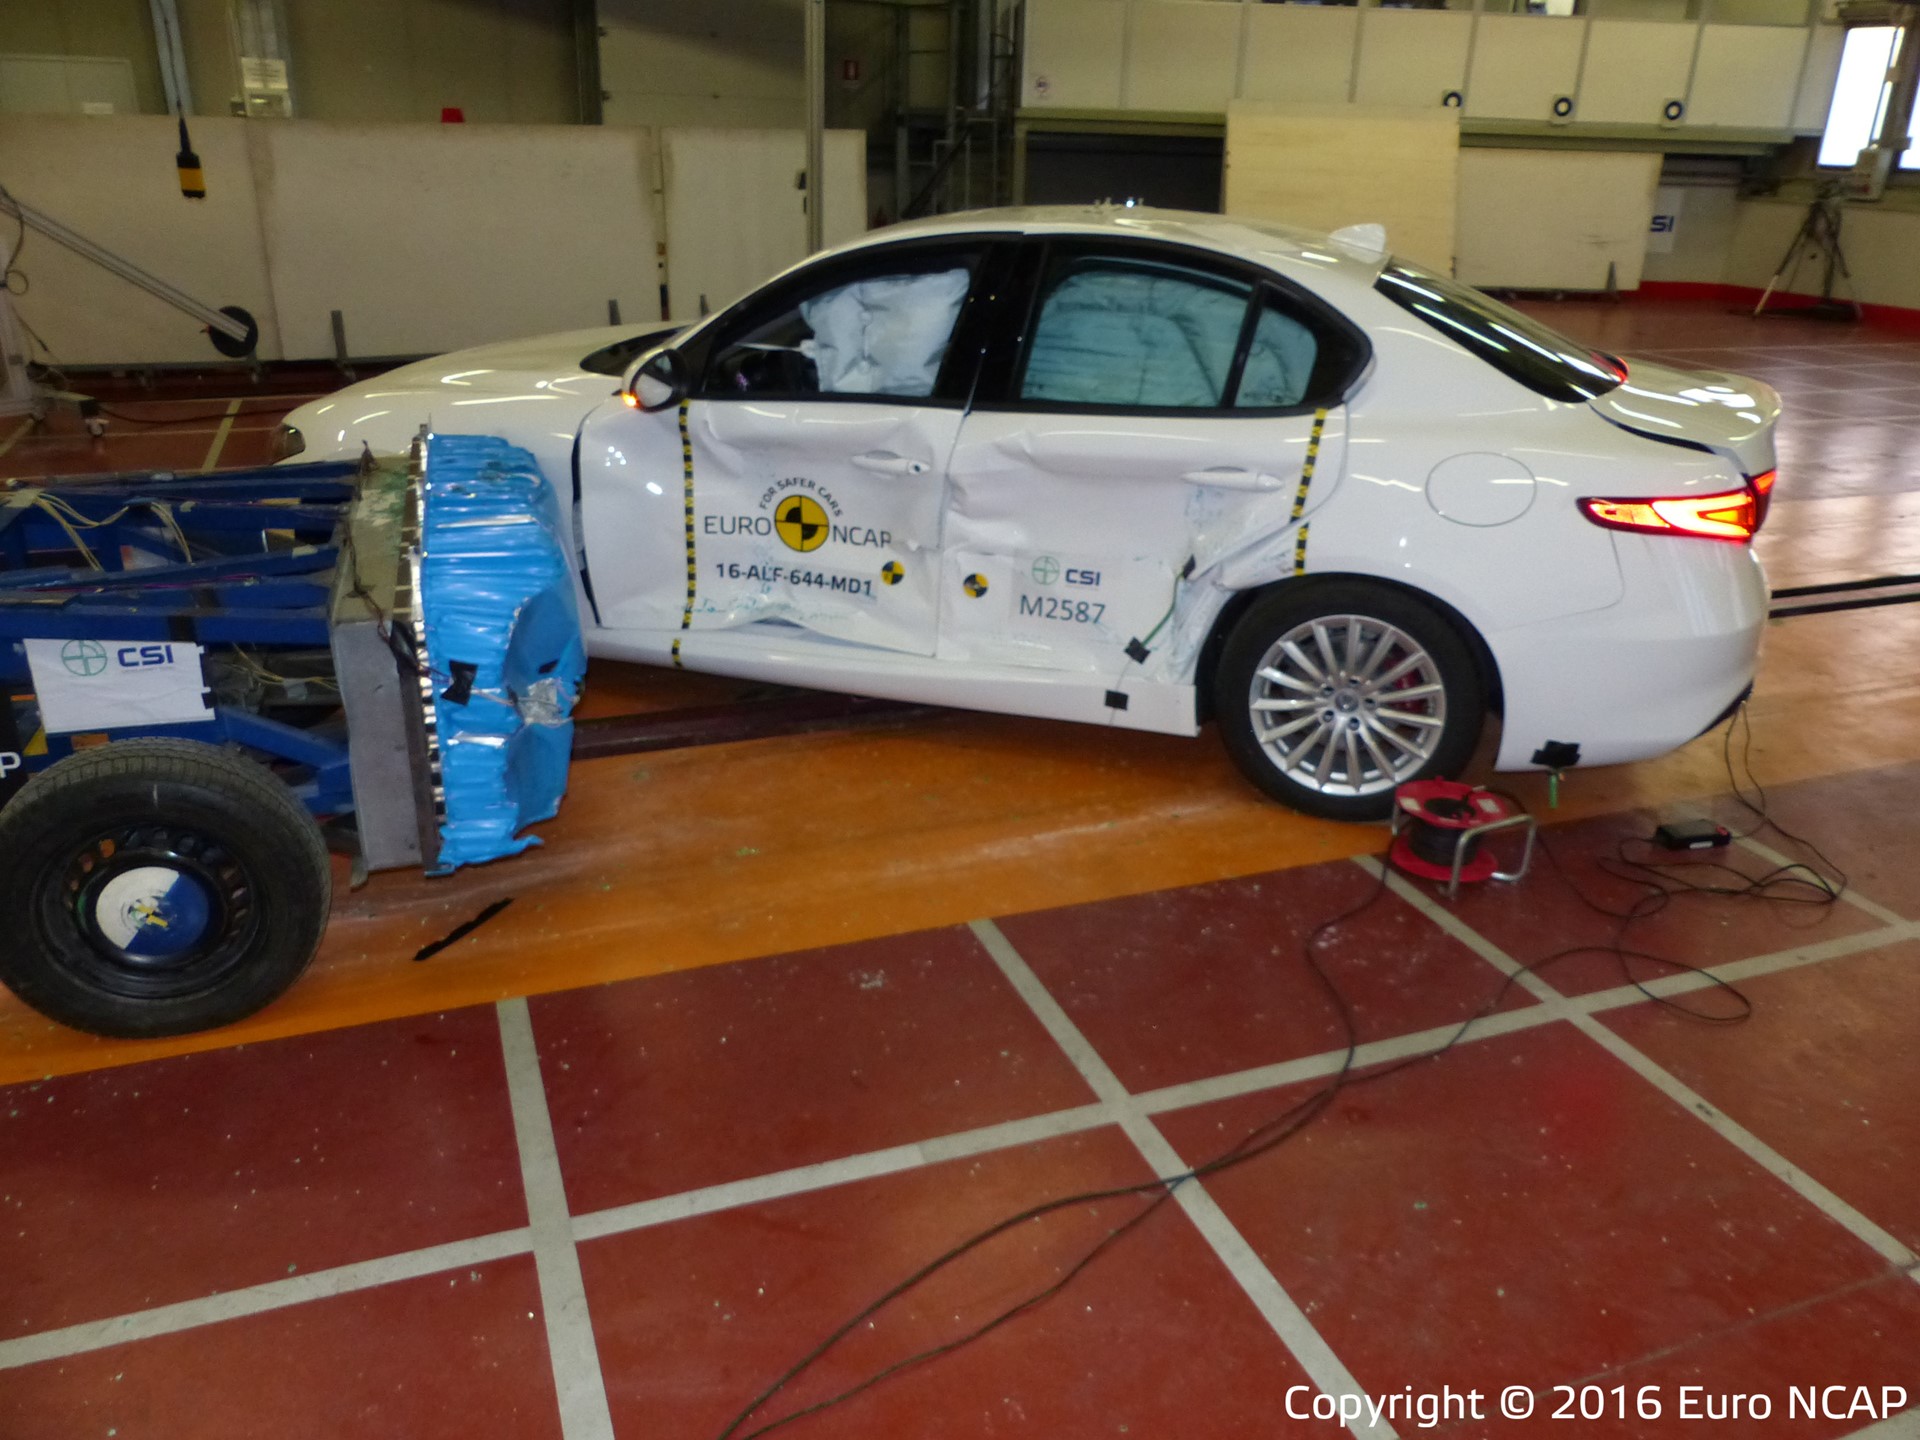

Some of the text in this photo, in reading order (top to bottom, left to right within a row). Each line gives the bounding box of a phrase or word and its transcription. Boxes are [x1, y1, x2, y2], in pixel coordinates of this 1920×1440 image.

[759, 477, 843, 517] FOR SAFER CARS
[704, 515, 772, 536] EURO
[716, 562, 874, 597] 16-ALF-644-MD1
[1065, 568, 1101, 586] CSI
[1020, 594, 1106, 624] M2587
[117, 644, 174, 667] CSI
